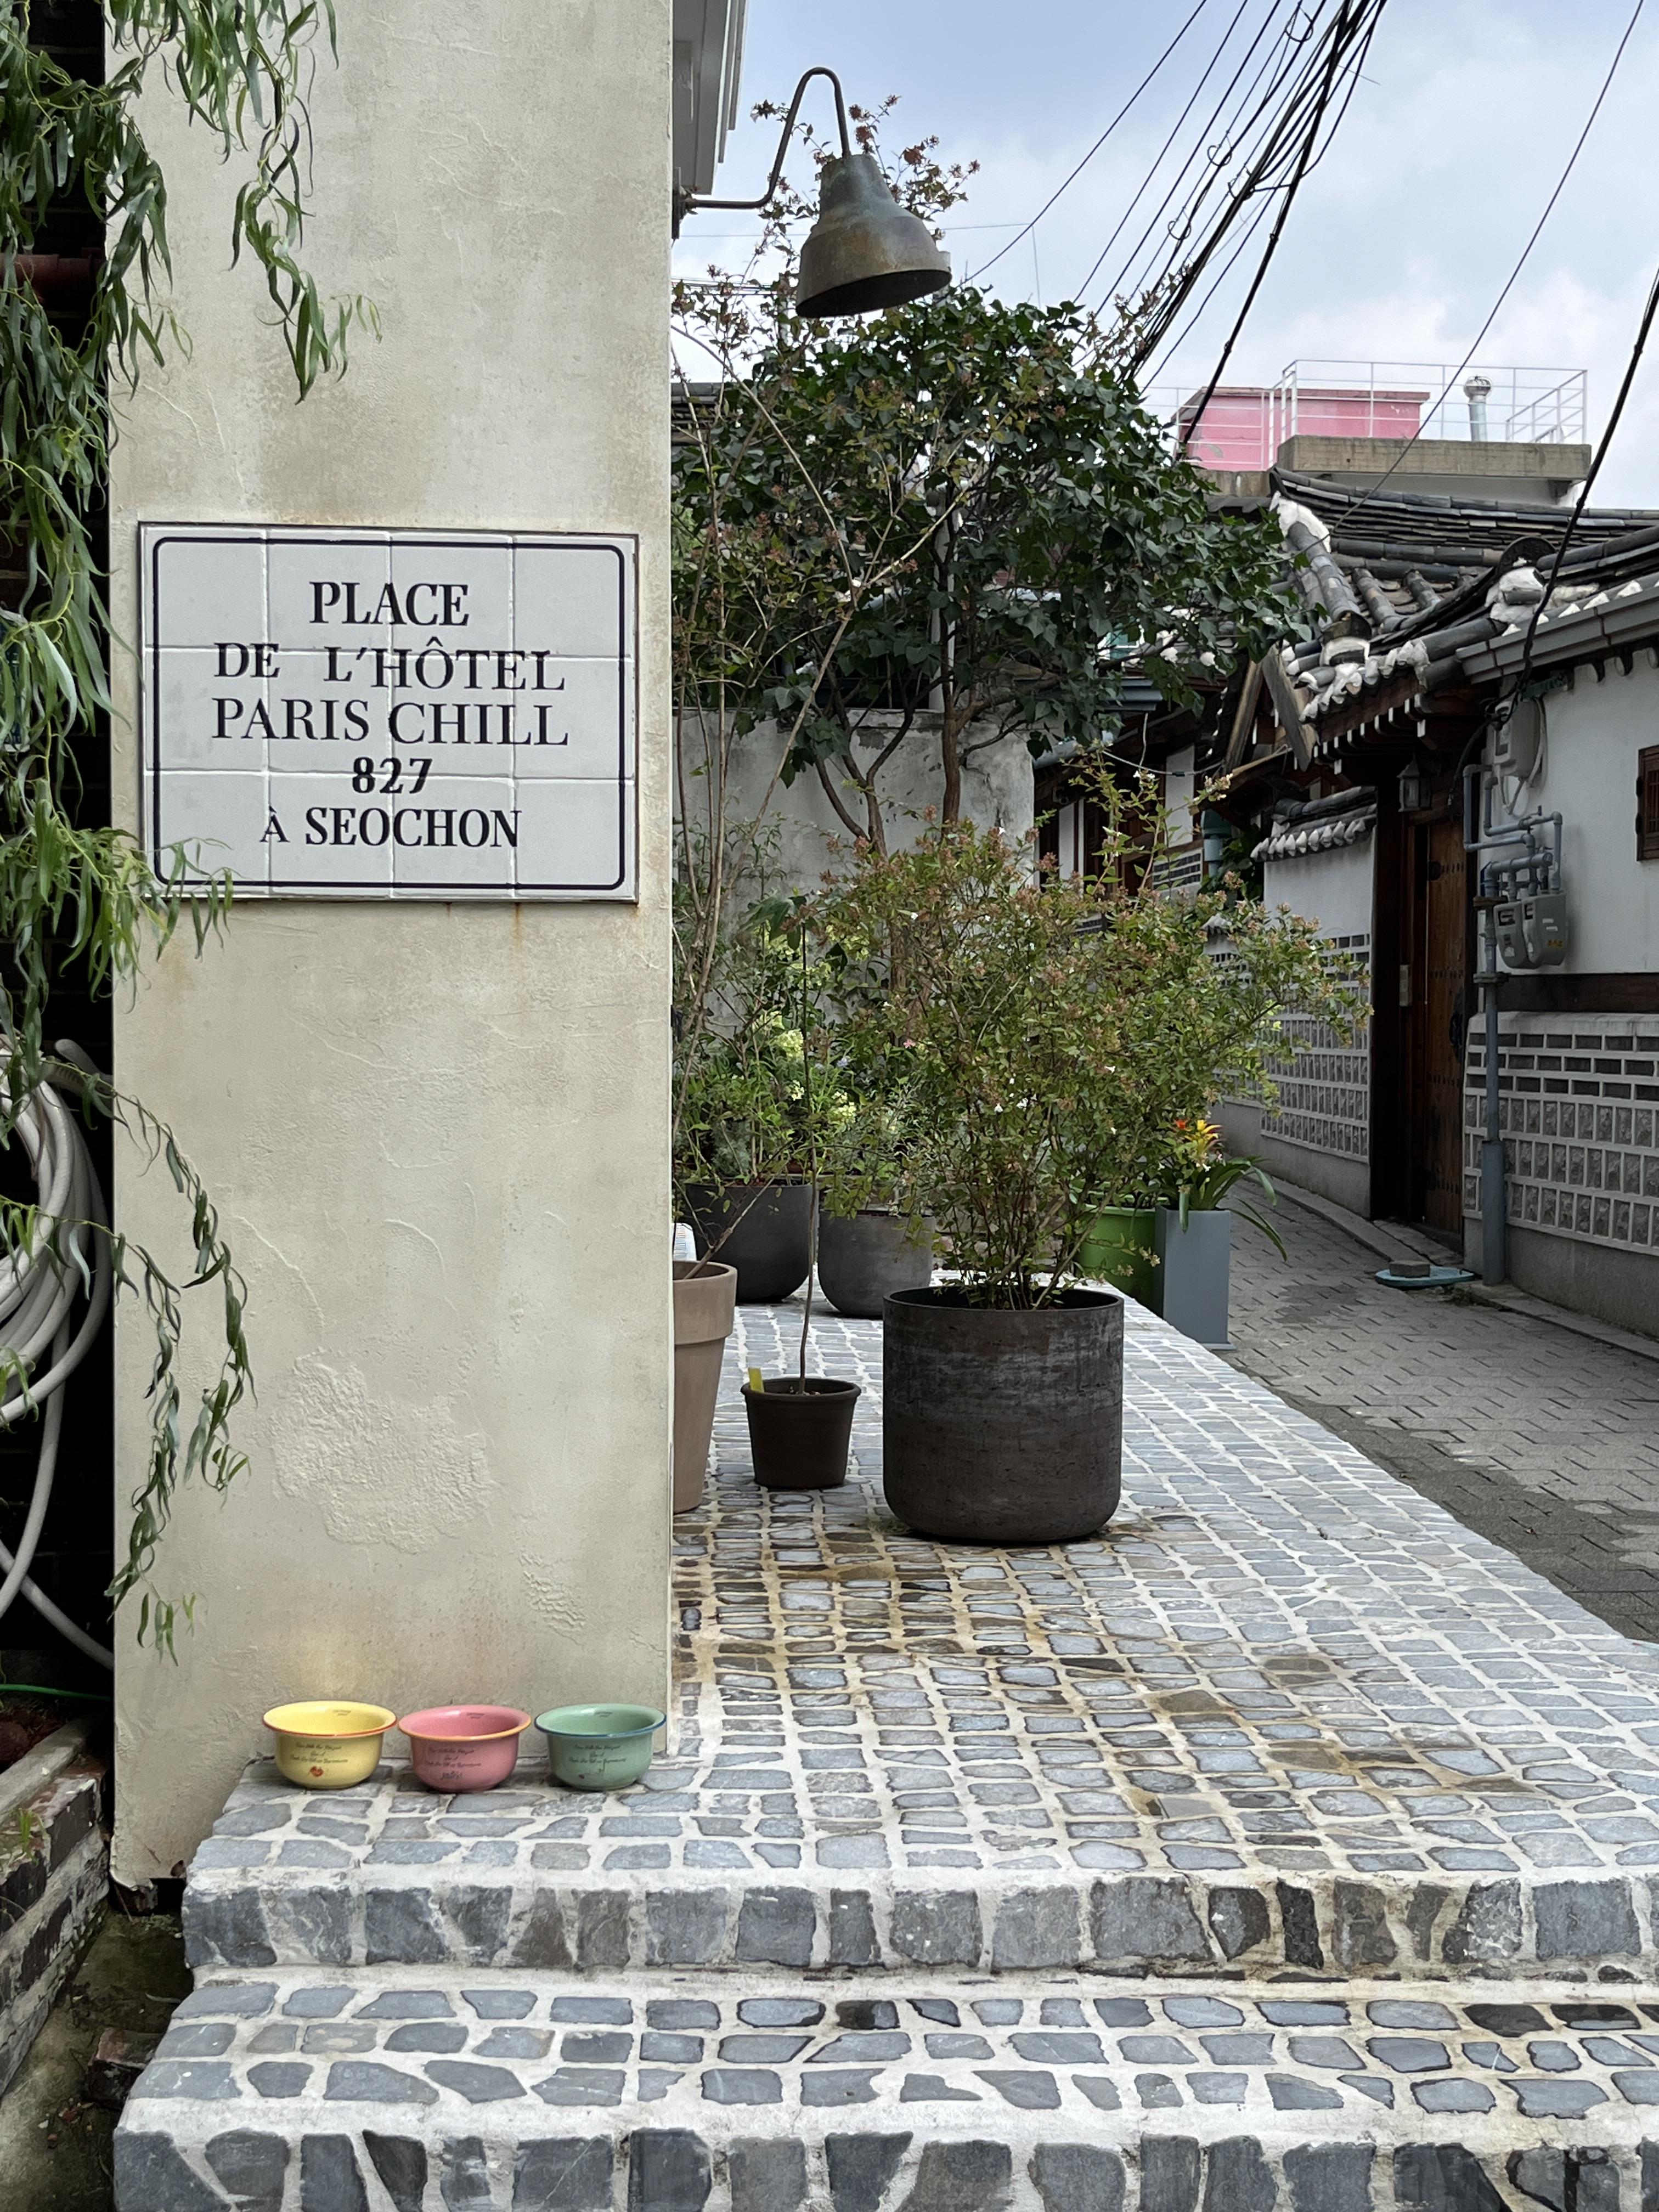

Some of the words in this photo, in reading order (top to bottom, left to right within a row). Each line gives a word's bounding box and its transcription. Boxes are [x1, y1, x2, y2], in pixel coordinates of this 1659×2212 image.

[310, 582, 469, 626] PLACE
[214, 643, 280, 678] DE
[324, 636, 565, 690] L'HÔTEL
[212, 698, 369, 741] PARIS
[388, 703, 568, 746] CHILL
[352, 757, 433, 794] 827
[260, 806, 289, 843] À
[305, 807, 521, 848] SEOCHON
